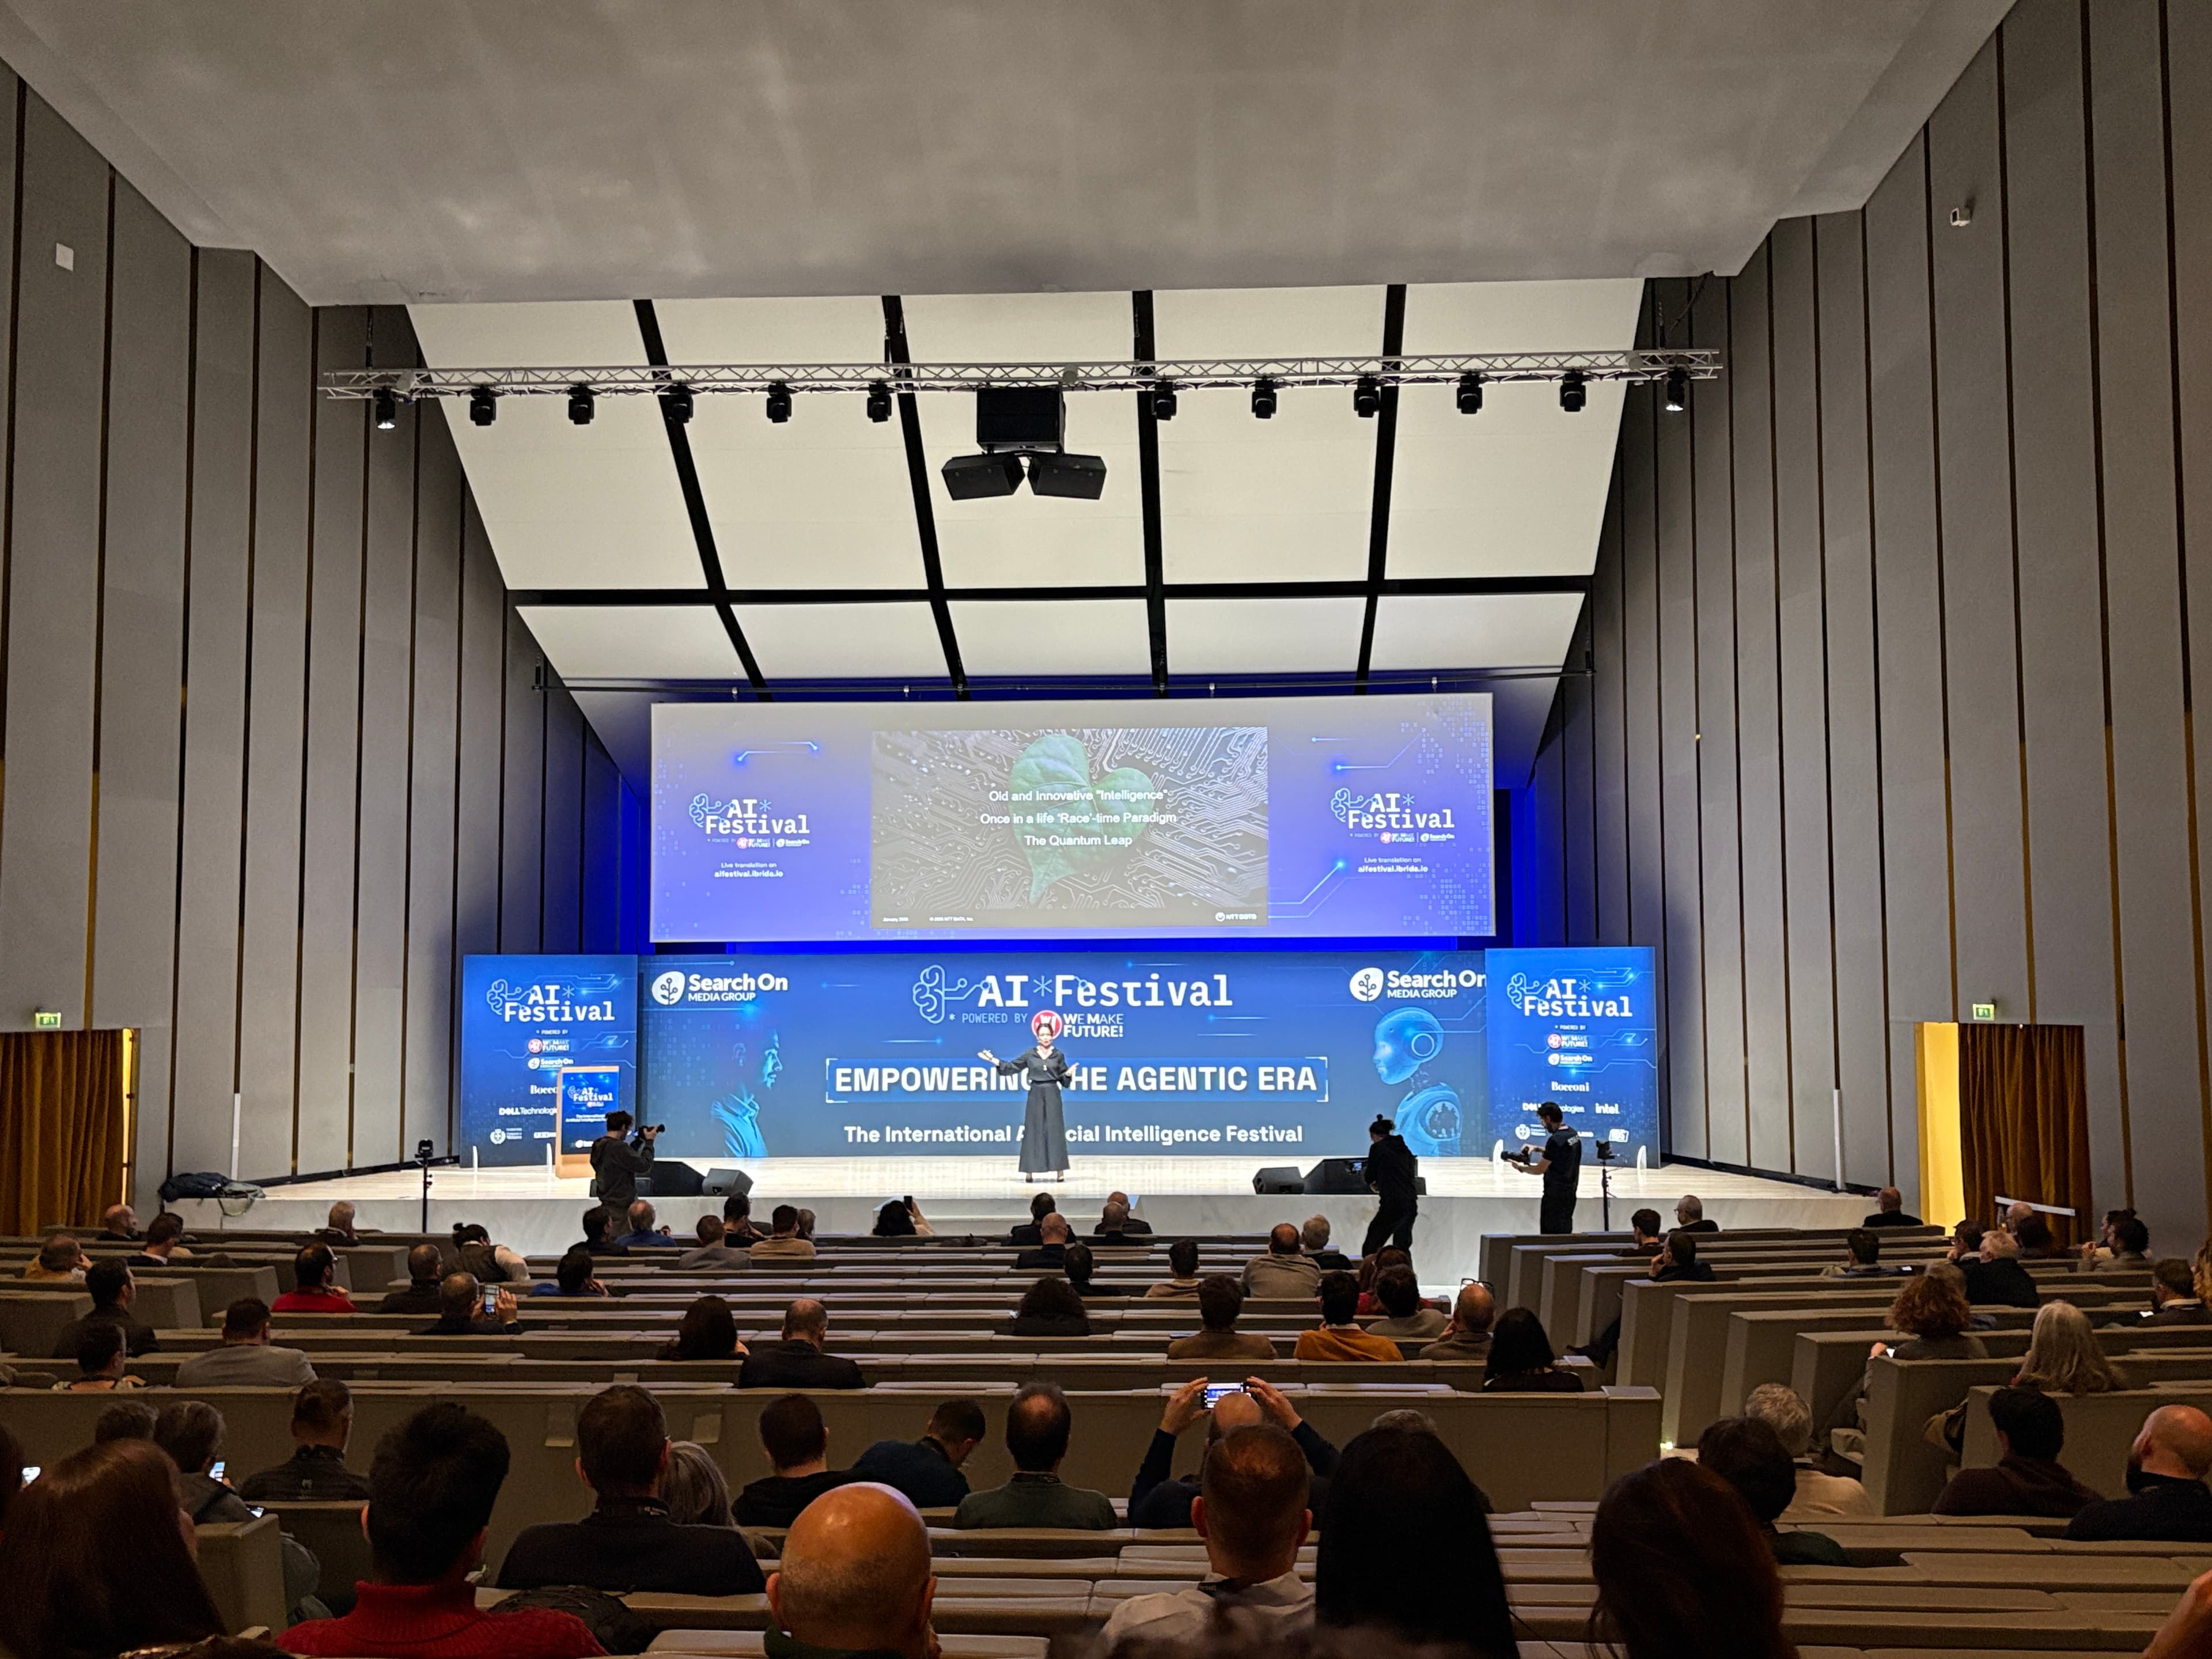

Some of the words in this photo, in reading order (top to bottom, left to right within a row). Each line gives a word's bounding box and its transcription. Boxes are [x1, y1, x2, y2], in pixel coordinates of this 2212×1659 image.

[989, 791, 1009, 801] Old
[1012, 791, 1032, 801] and
[1036, 790, 1093, 801] Innovative
[1370, 793, 1400, 812] AI
[727, 799, 757, 818] AI
[706, 815, 810, 834] Festival
[980, 814, 1010, 824] Once
[1013, 813, 1024, 824] in
[1026, 816, 1033, 824] a
[1036, 813, 1055, 824] life
[1123, 813, 1177, 825] Paradigm
[1349, 809, 1455, 829] Festival
[1025, 836, 1047, 846] The
[1049, 835, 1101, 846] Quantum
[1104, 835, 1132, 847] Leap
[688, 973, 756, 991] Search
[757, 973, 788, 991] On
[1387, 970, 1457, 988] Search
[528, 985, 560, 1005] AI
[688, 993, 720, 1002] MEDIA
[721, 992, 756, 1001] GROUP
[1387, 989, 1420, 998] MEDIA
[1421, 988, 1457, 998] GROUP
[1546, 979, 1577, 999] AI
[505, 1001, 615, 1022] Festival
[1524, 995, 1633, 1017] Festival
[962, 1013, 1008, 1024] POWERED
[1014, 1013, 1028, 1023] BY
[1063, 1013, 1085, 1024] WE
[1087, 1013, 1124, 1024] MAKE
[1063, 1025, 1123, 1037] FUTURE!
[1057, 1067, 1107, 1090] HE
[1116, 1066, 1247, 1091] AGENTIC
[1258, 1066, 1317, 1090] ERA
[1551, 1081, 1590, 1092] Bocconi
[573, 1092, 613, 1101] Festival
[844, 1126, 880, 1142] The
[886, 1125, 1011, 1142] International
[1105, 1125, 1221, 1146] Intelligence
[1226, 1125, 1303, 1142] Festival
